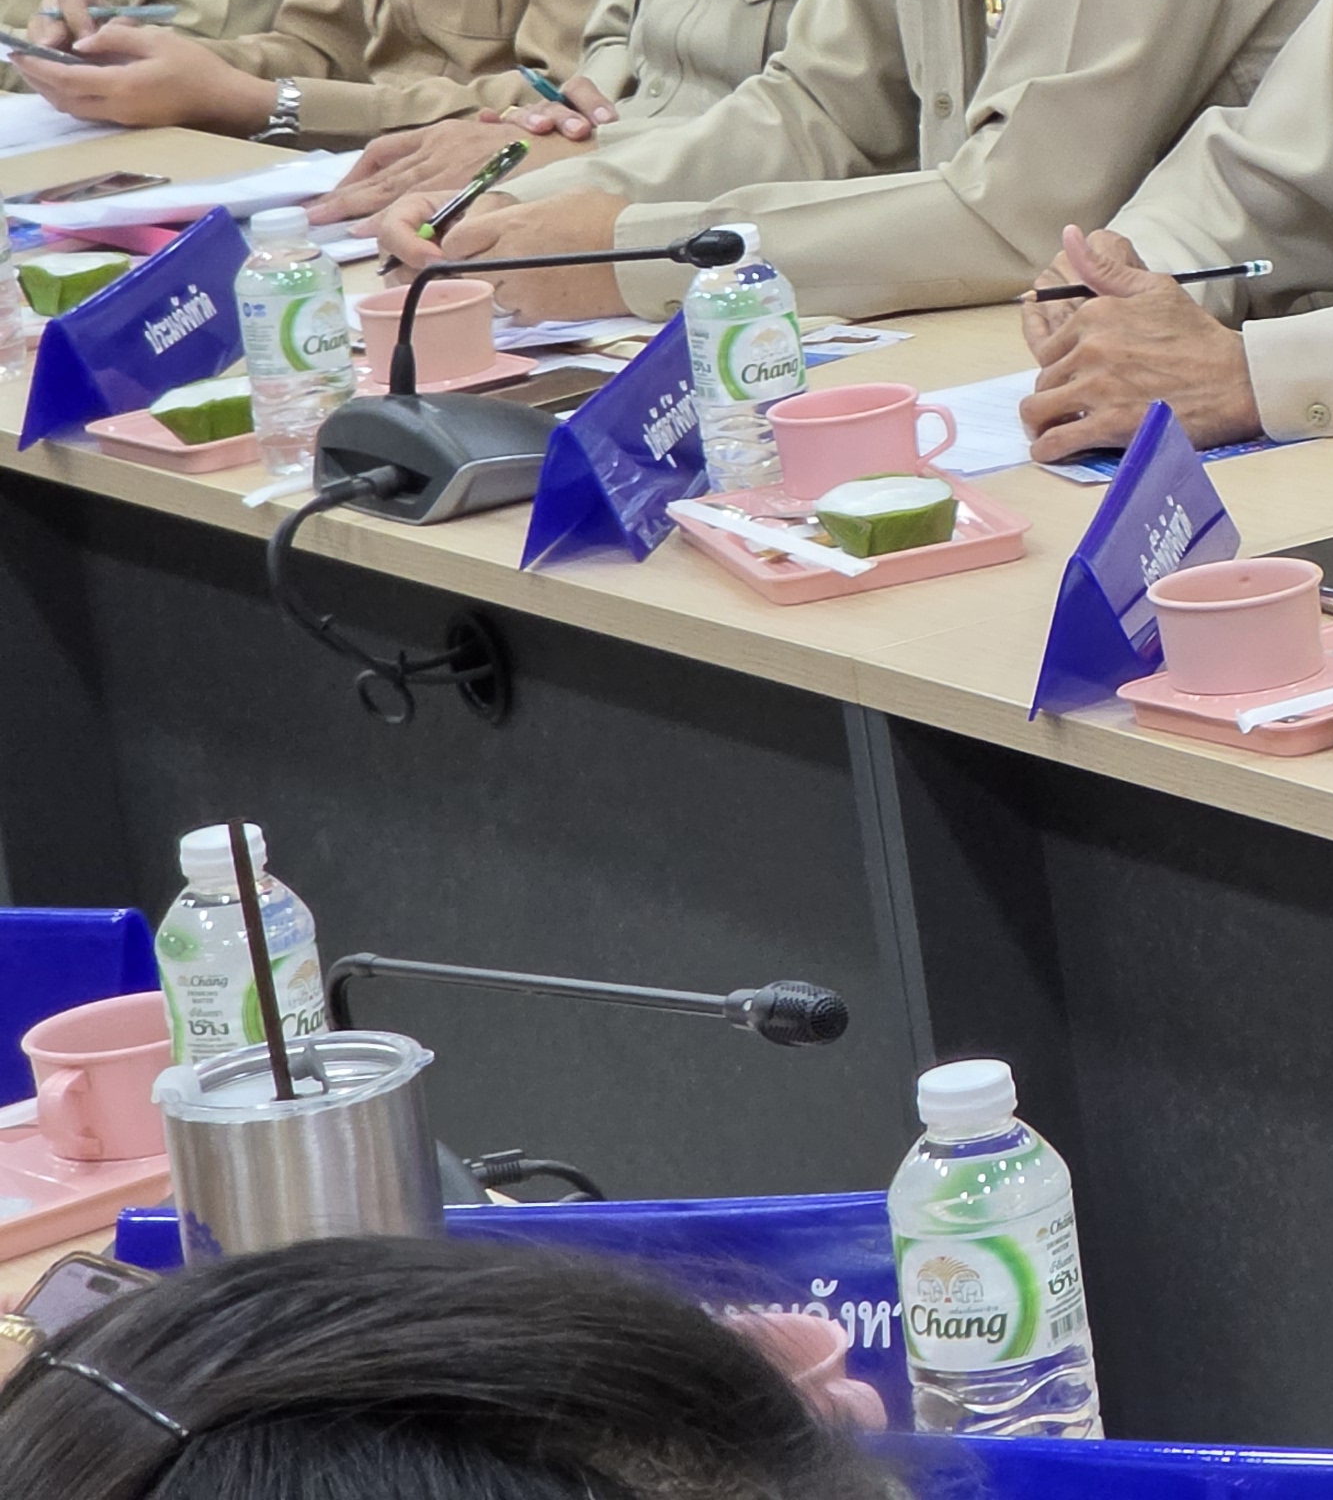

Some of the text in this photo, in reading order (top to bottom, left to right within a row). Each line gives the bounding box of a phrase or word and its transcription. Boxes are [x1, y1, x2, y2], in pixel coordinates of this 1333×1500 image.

[303, 331, 349, 356] Chan
[741, 357, 800, 386] Chang
[642, 379, 699, 469] ปศุสัตว์จังหวั
[190, 974, 229, 989] Chang
[909, 1303, 1009, 1345] Chang
